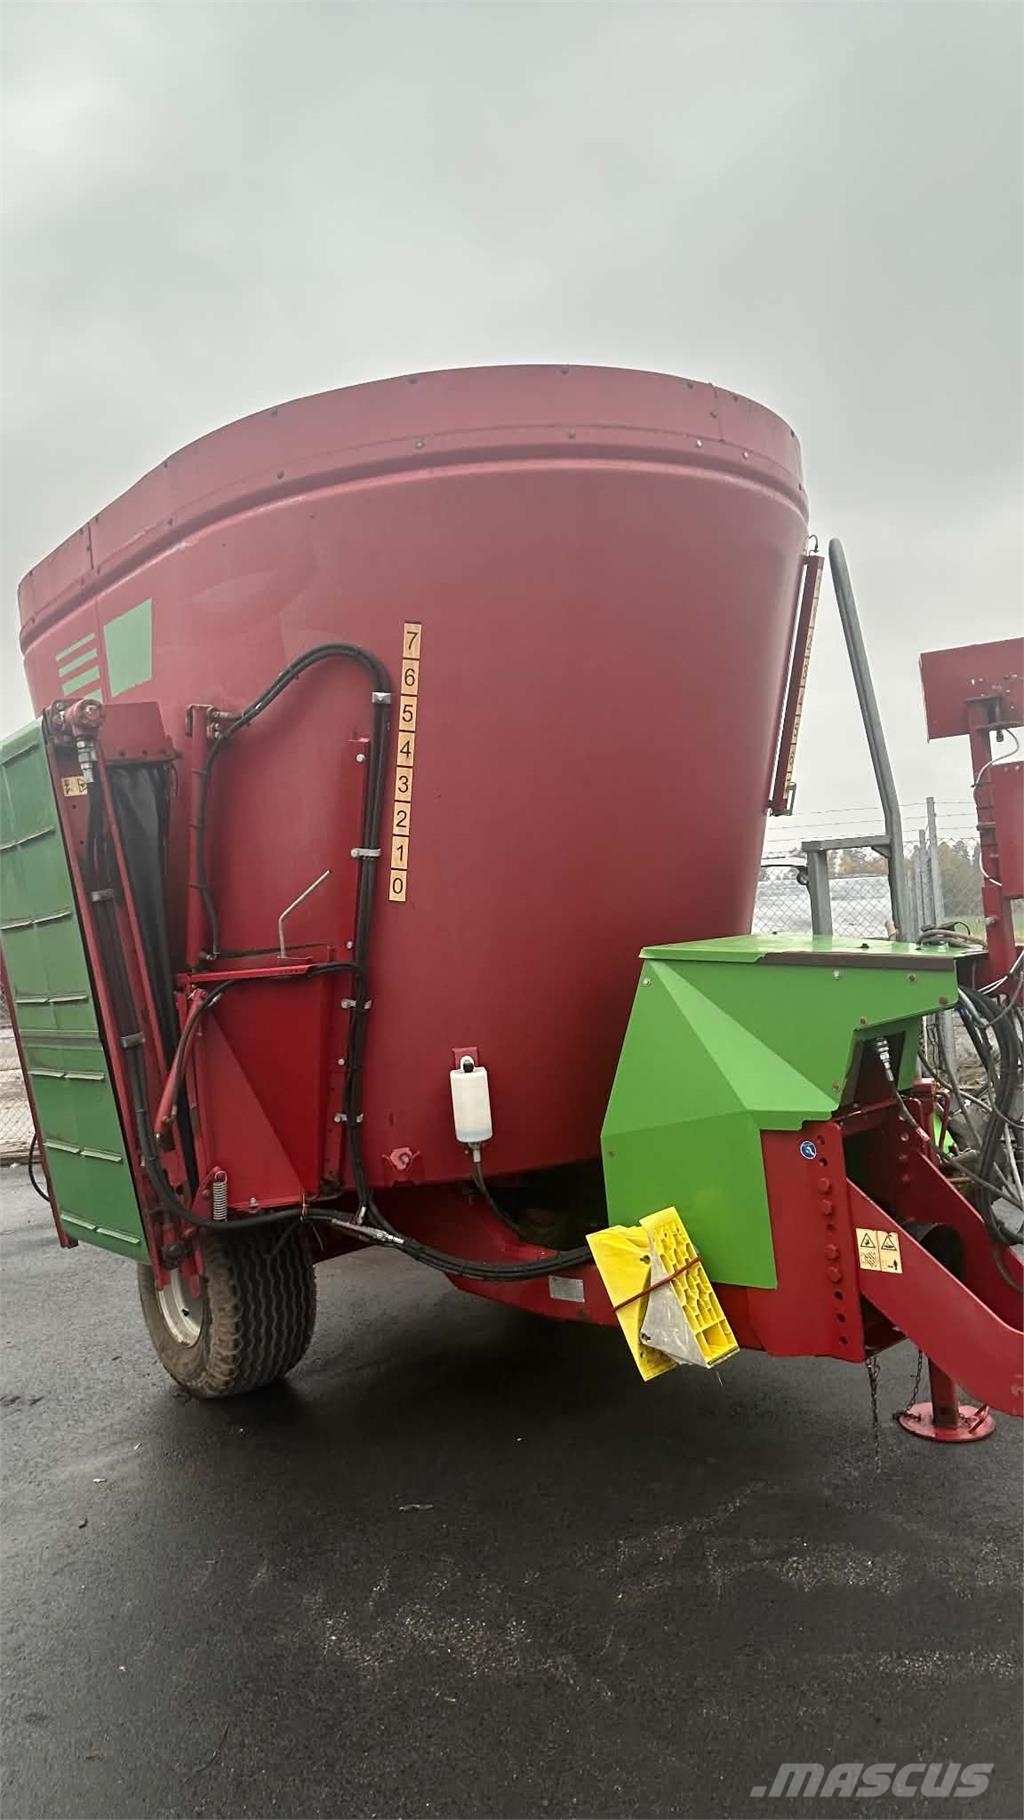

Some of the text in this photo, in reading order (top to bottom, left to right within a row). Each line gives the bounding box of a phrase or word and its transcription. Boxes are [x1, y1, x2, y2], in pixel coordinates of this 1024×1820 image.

[406, 631, 418, 651] 7
[404, 667, 416, 687] 6
[402, 703, 414, 723] 5
[399, 740, 412, 759] 4
[397, 775, 409, 794] 3
[395, 809, 408, 828] 2
[396, 844, 405, 861] 1
[392, 877, 403, 895] 0
